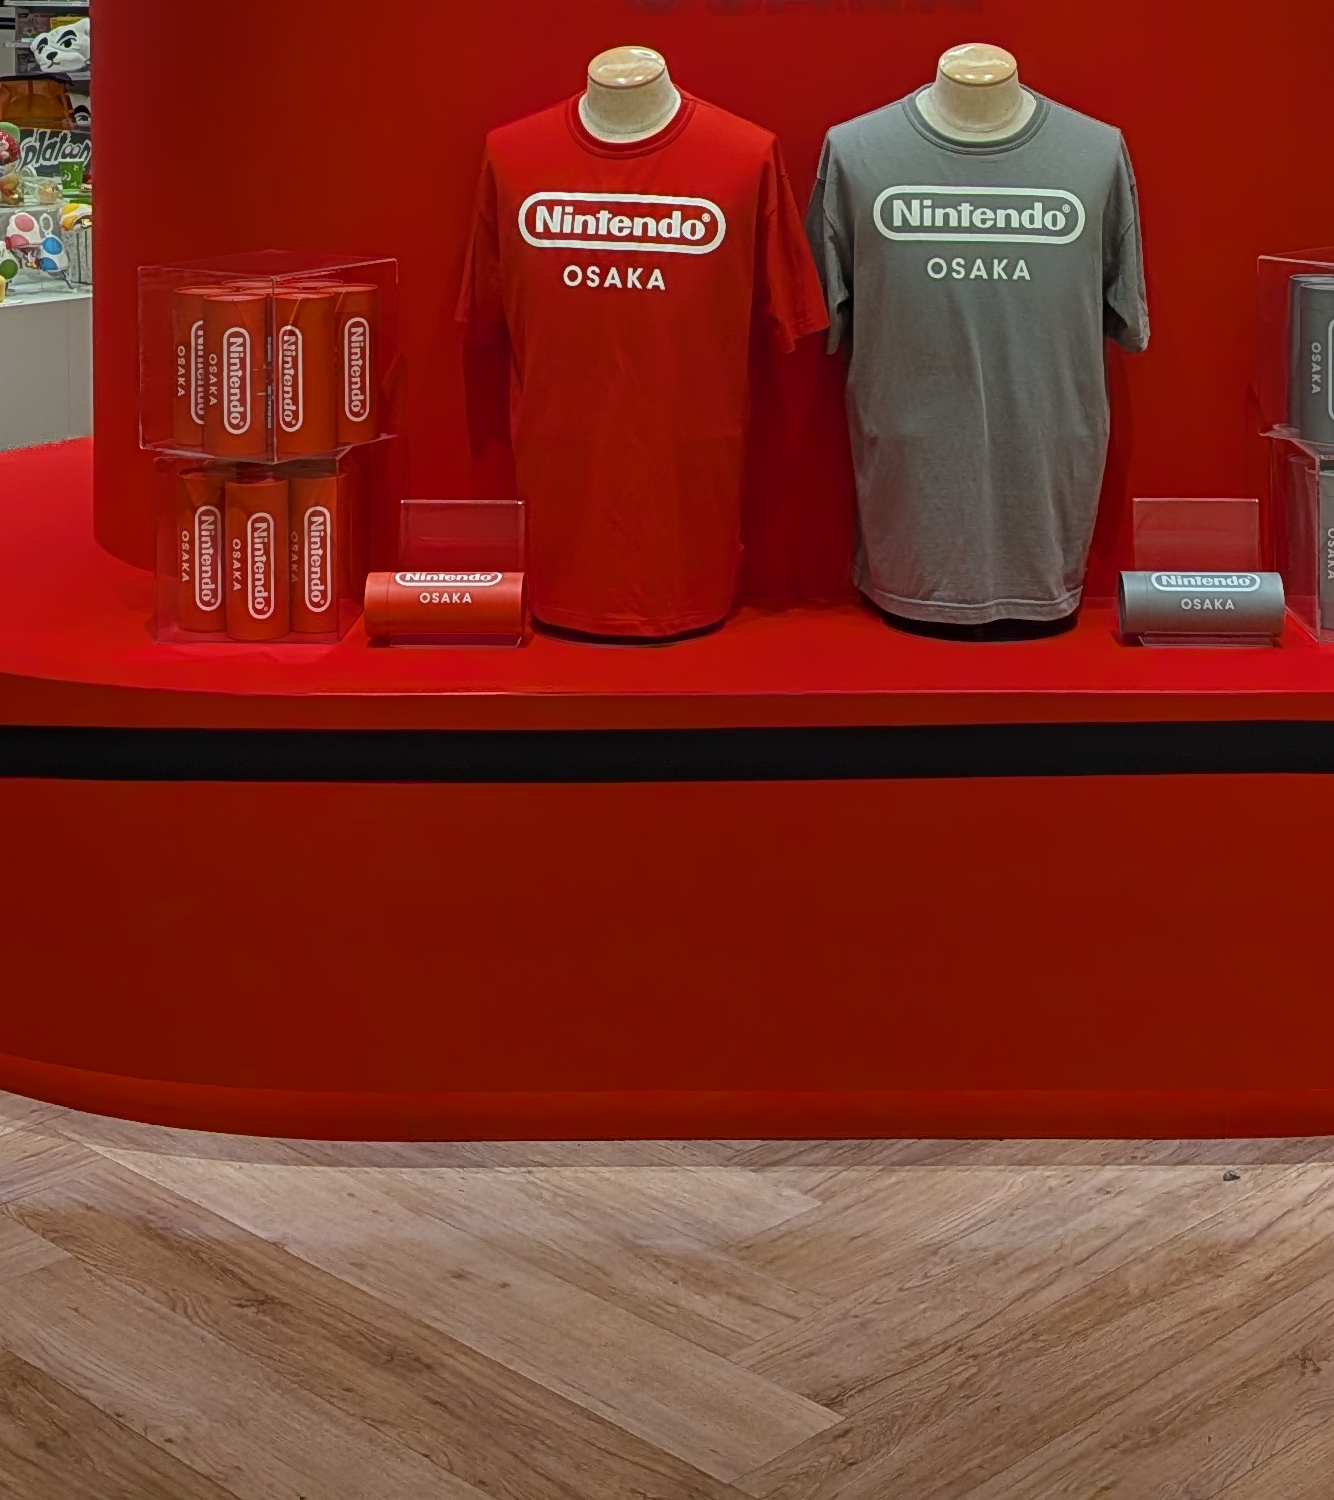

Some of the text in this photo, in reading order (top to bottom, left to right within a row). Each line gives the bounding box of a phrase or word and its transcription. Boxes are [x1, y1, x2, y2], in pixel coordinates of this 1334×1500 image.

[17, 128, 91, 176] platoon
[562, 265, 667, 291] OSAKA
[927, 257, 1031, 281] OSAKA
[177, 345, 186, 397] OSAKA
[209, 353, 218, 406] OSAKA
[1311, 341, 1321, 395] OSAKA
[181, 530, 190, 582] OSAKA
[232, 538, 242, 591] OSAKA
[419, 591, 473, 604] OSAKA
[1180, 598, 1235, 611] OSAKA
